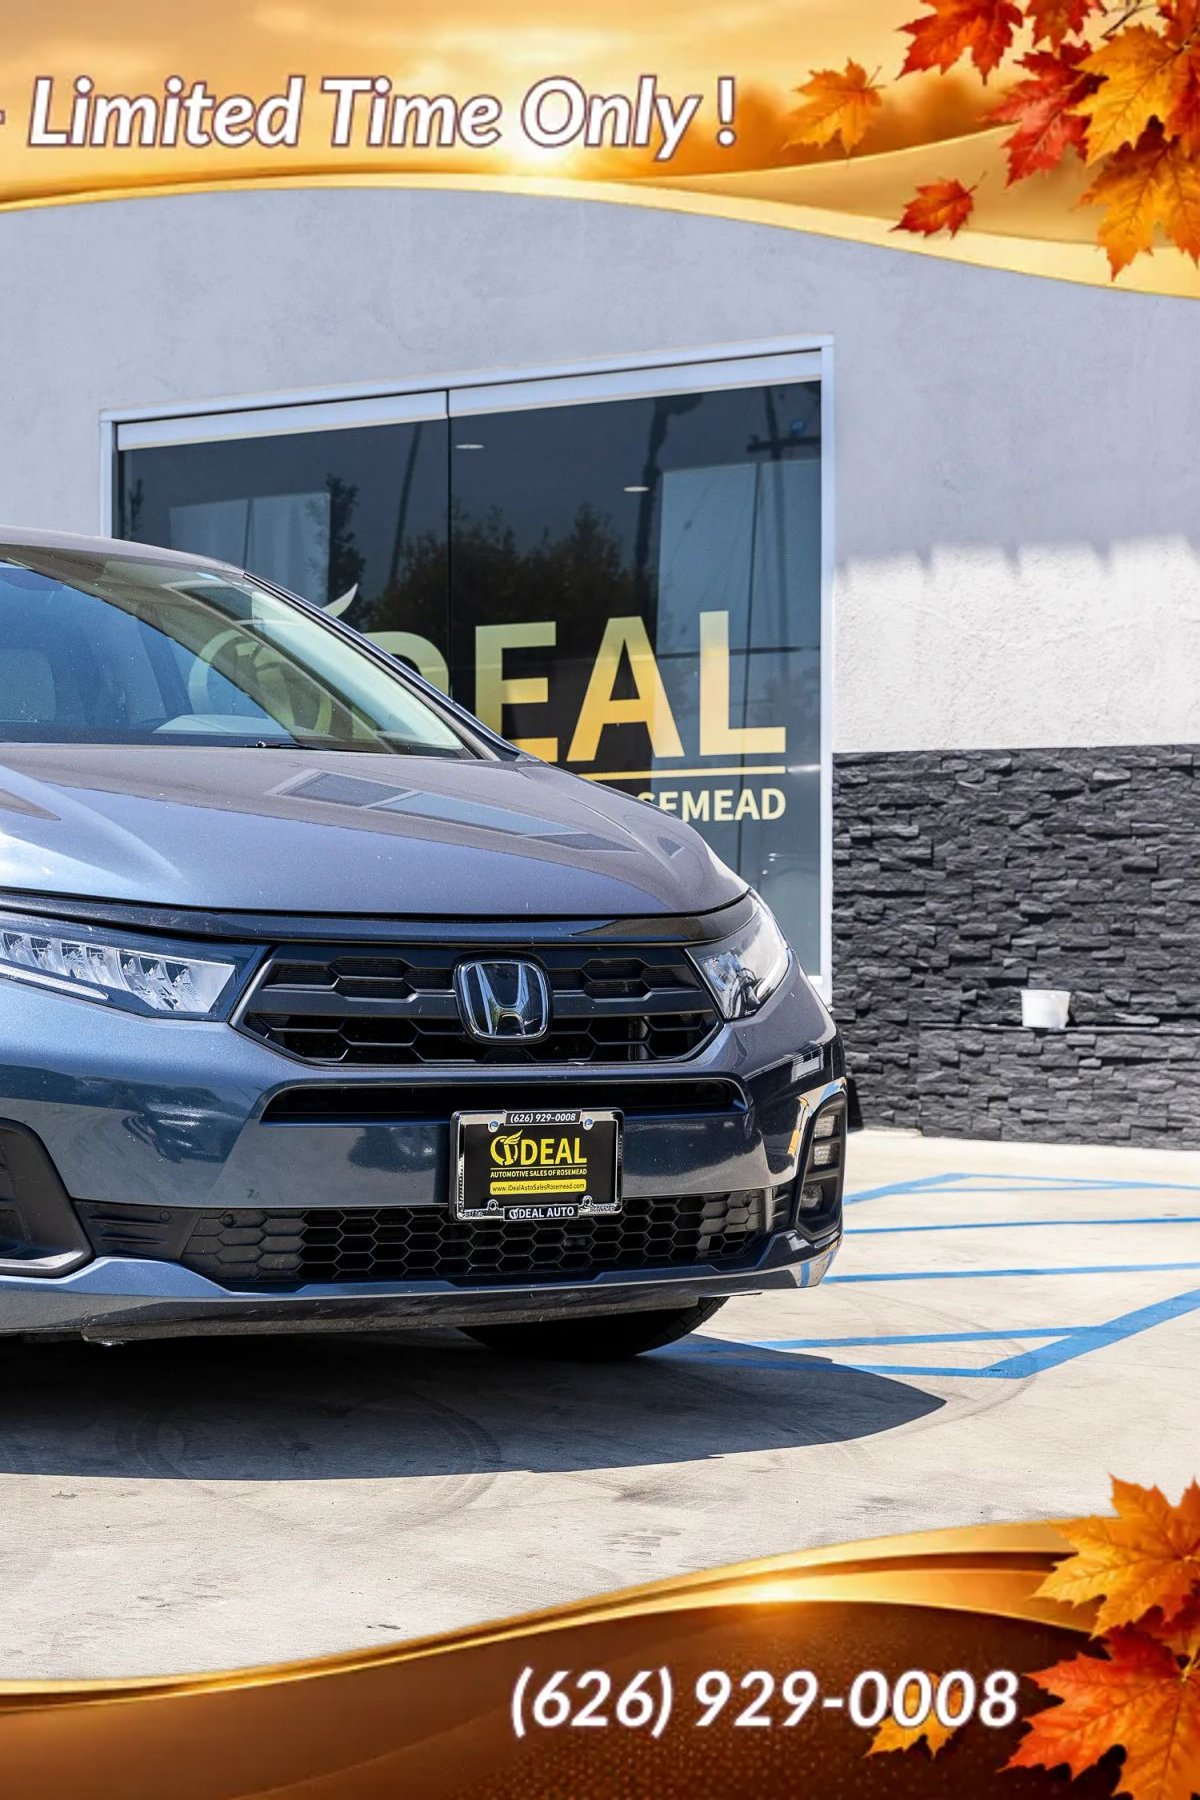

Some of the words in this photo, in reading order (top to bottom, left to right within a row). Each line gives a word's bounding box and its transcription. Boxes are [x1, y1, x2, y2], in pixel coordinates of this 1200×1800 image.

[510, 1113, 534, 1123] (626)
[535, 1112, 576, 1122] 929-0008
[490, 1169, 529, 1178] AUTOMOTIVE
[530, 1169, 548, 1177] SALES
[548, 1169, 557, 1177] OF
[557, 1168, 587, 1177] ROSEMEAD
[546, 1206, 575, 1218] AUTO
